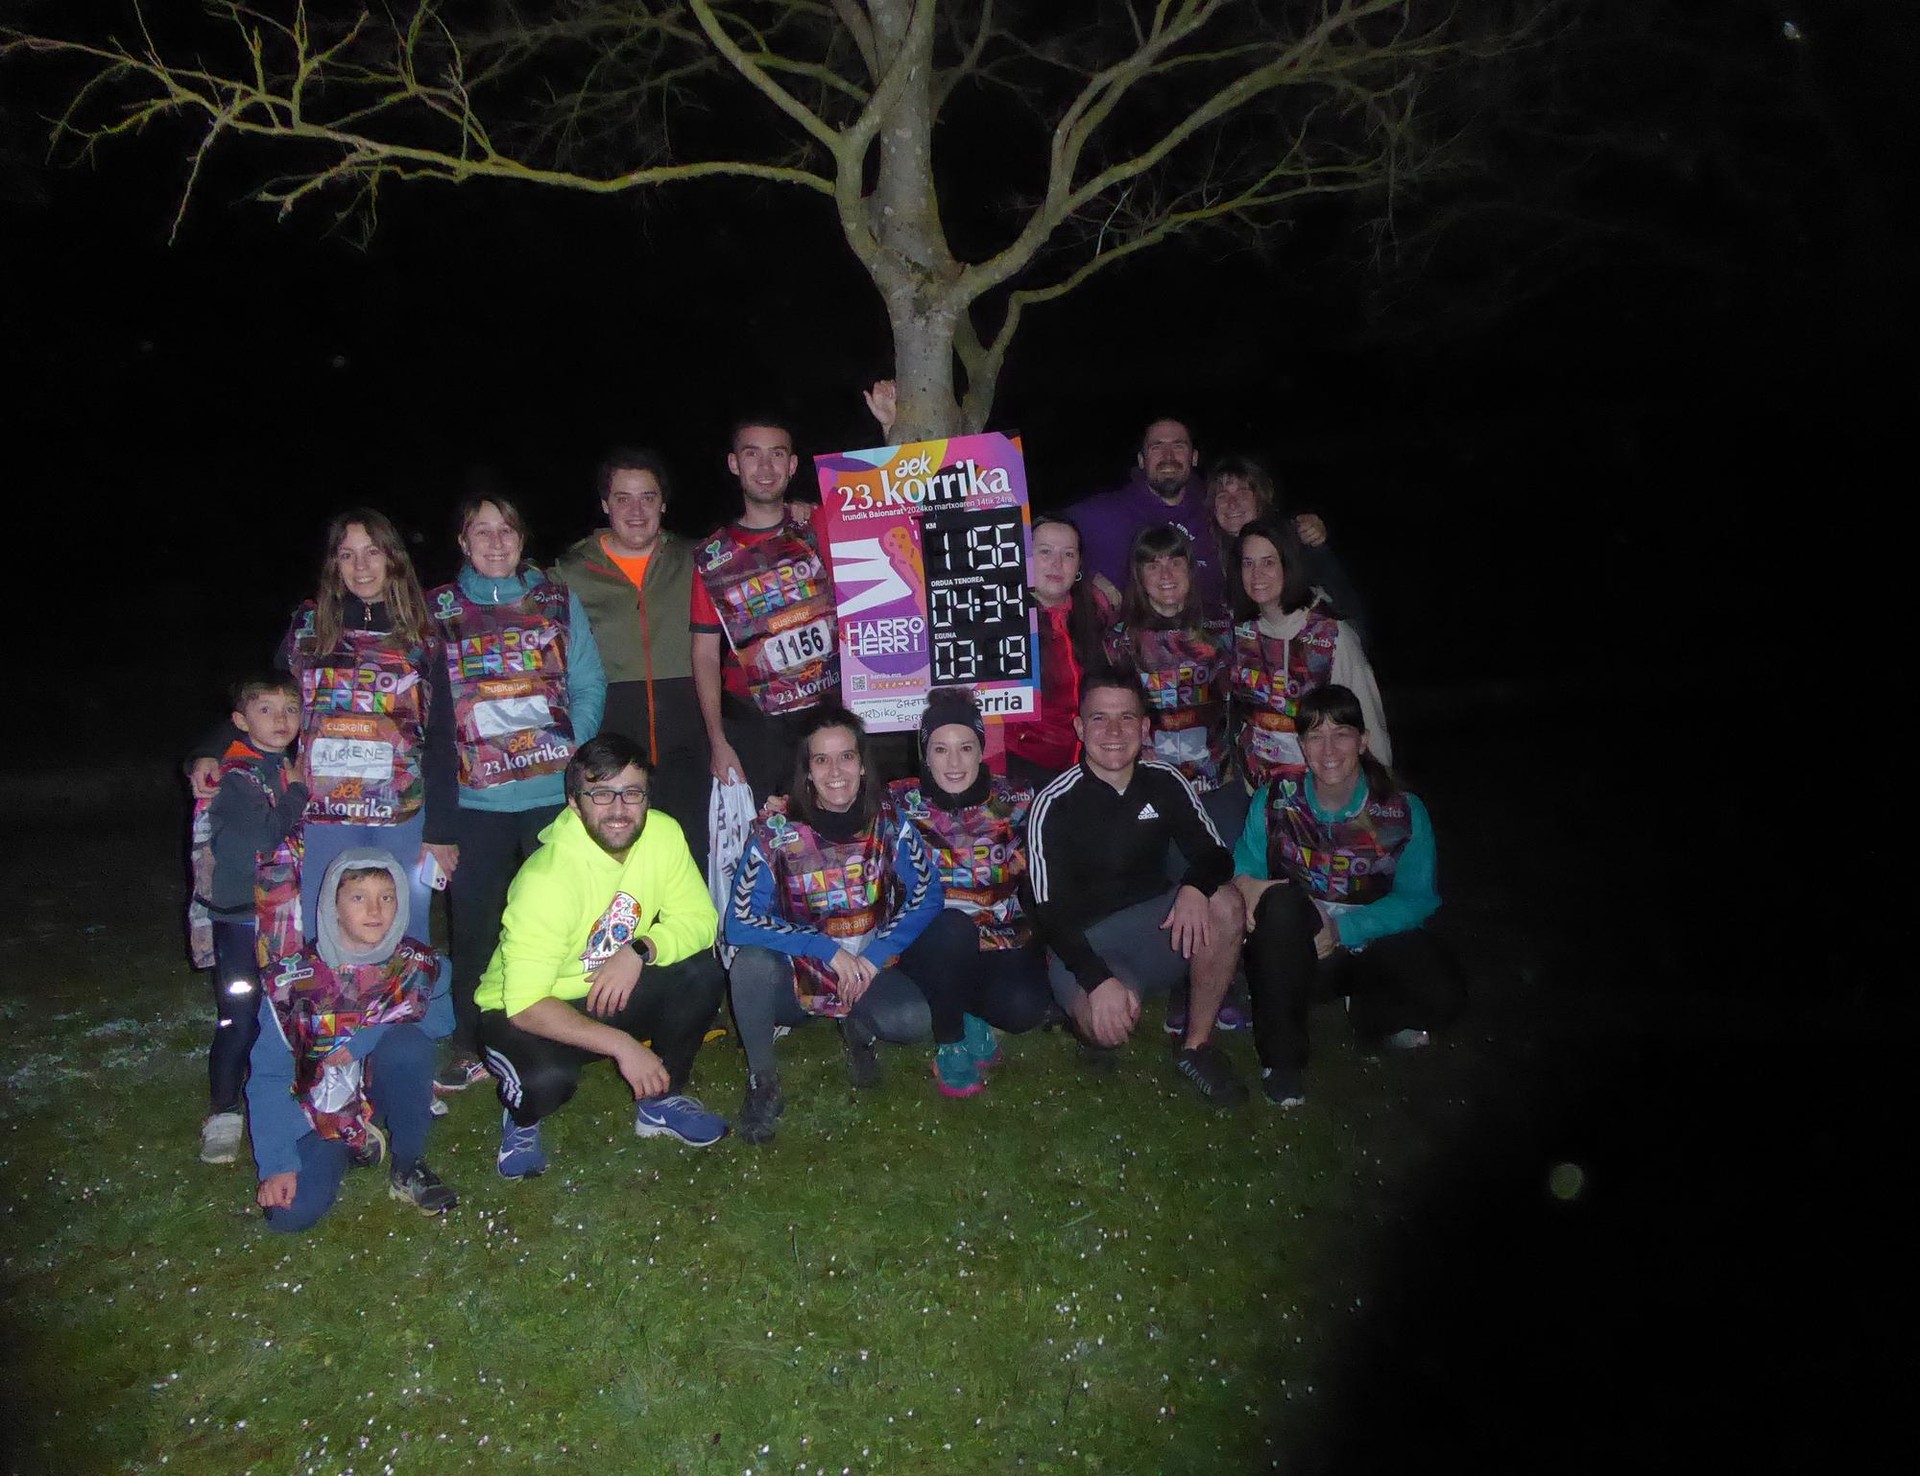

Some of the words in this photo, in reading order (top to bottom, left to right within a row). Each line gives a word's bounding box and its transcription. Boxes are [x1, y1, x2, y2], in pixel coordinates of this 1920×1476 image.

[895, 450, 932, 478] aek
[837, 458, 1012, 512] 23.korrika
[842, 511, 868, 522] Irundik
[868, 507, 905, 519] Baionarat
[906, 504, 933, 515] 2024ko
[934, 501, 975, 512] martxoaren
[925, 522, 937, 530] KM
[930, 579, 953, 587] ORDUA
[953, 576, 985, 585] TENOREA
[931, 583, 1024, 628] 04:34
[846, 616, 925, 640] HARRO
[934, 632, 957, 640] EGUNA
[776, 626, 824, 665] 1156
[777, 671, 841, 705] 23.korrika
[975, 690, 1023, 712] erria
[483, 743, 570, 777] 23.korrika
[303, 796, 393, 819] 23.korrika
